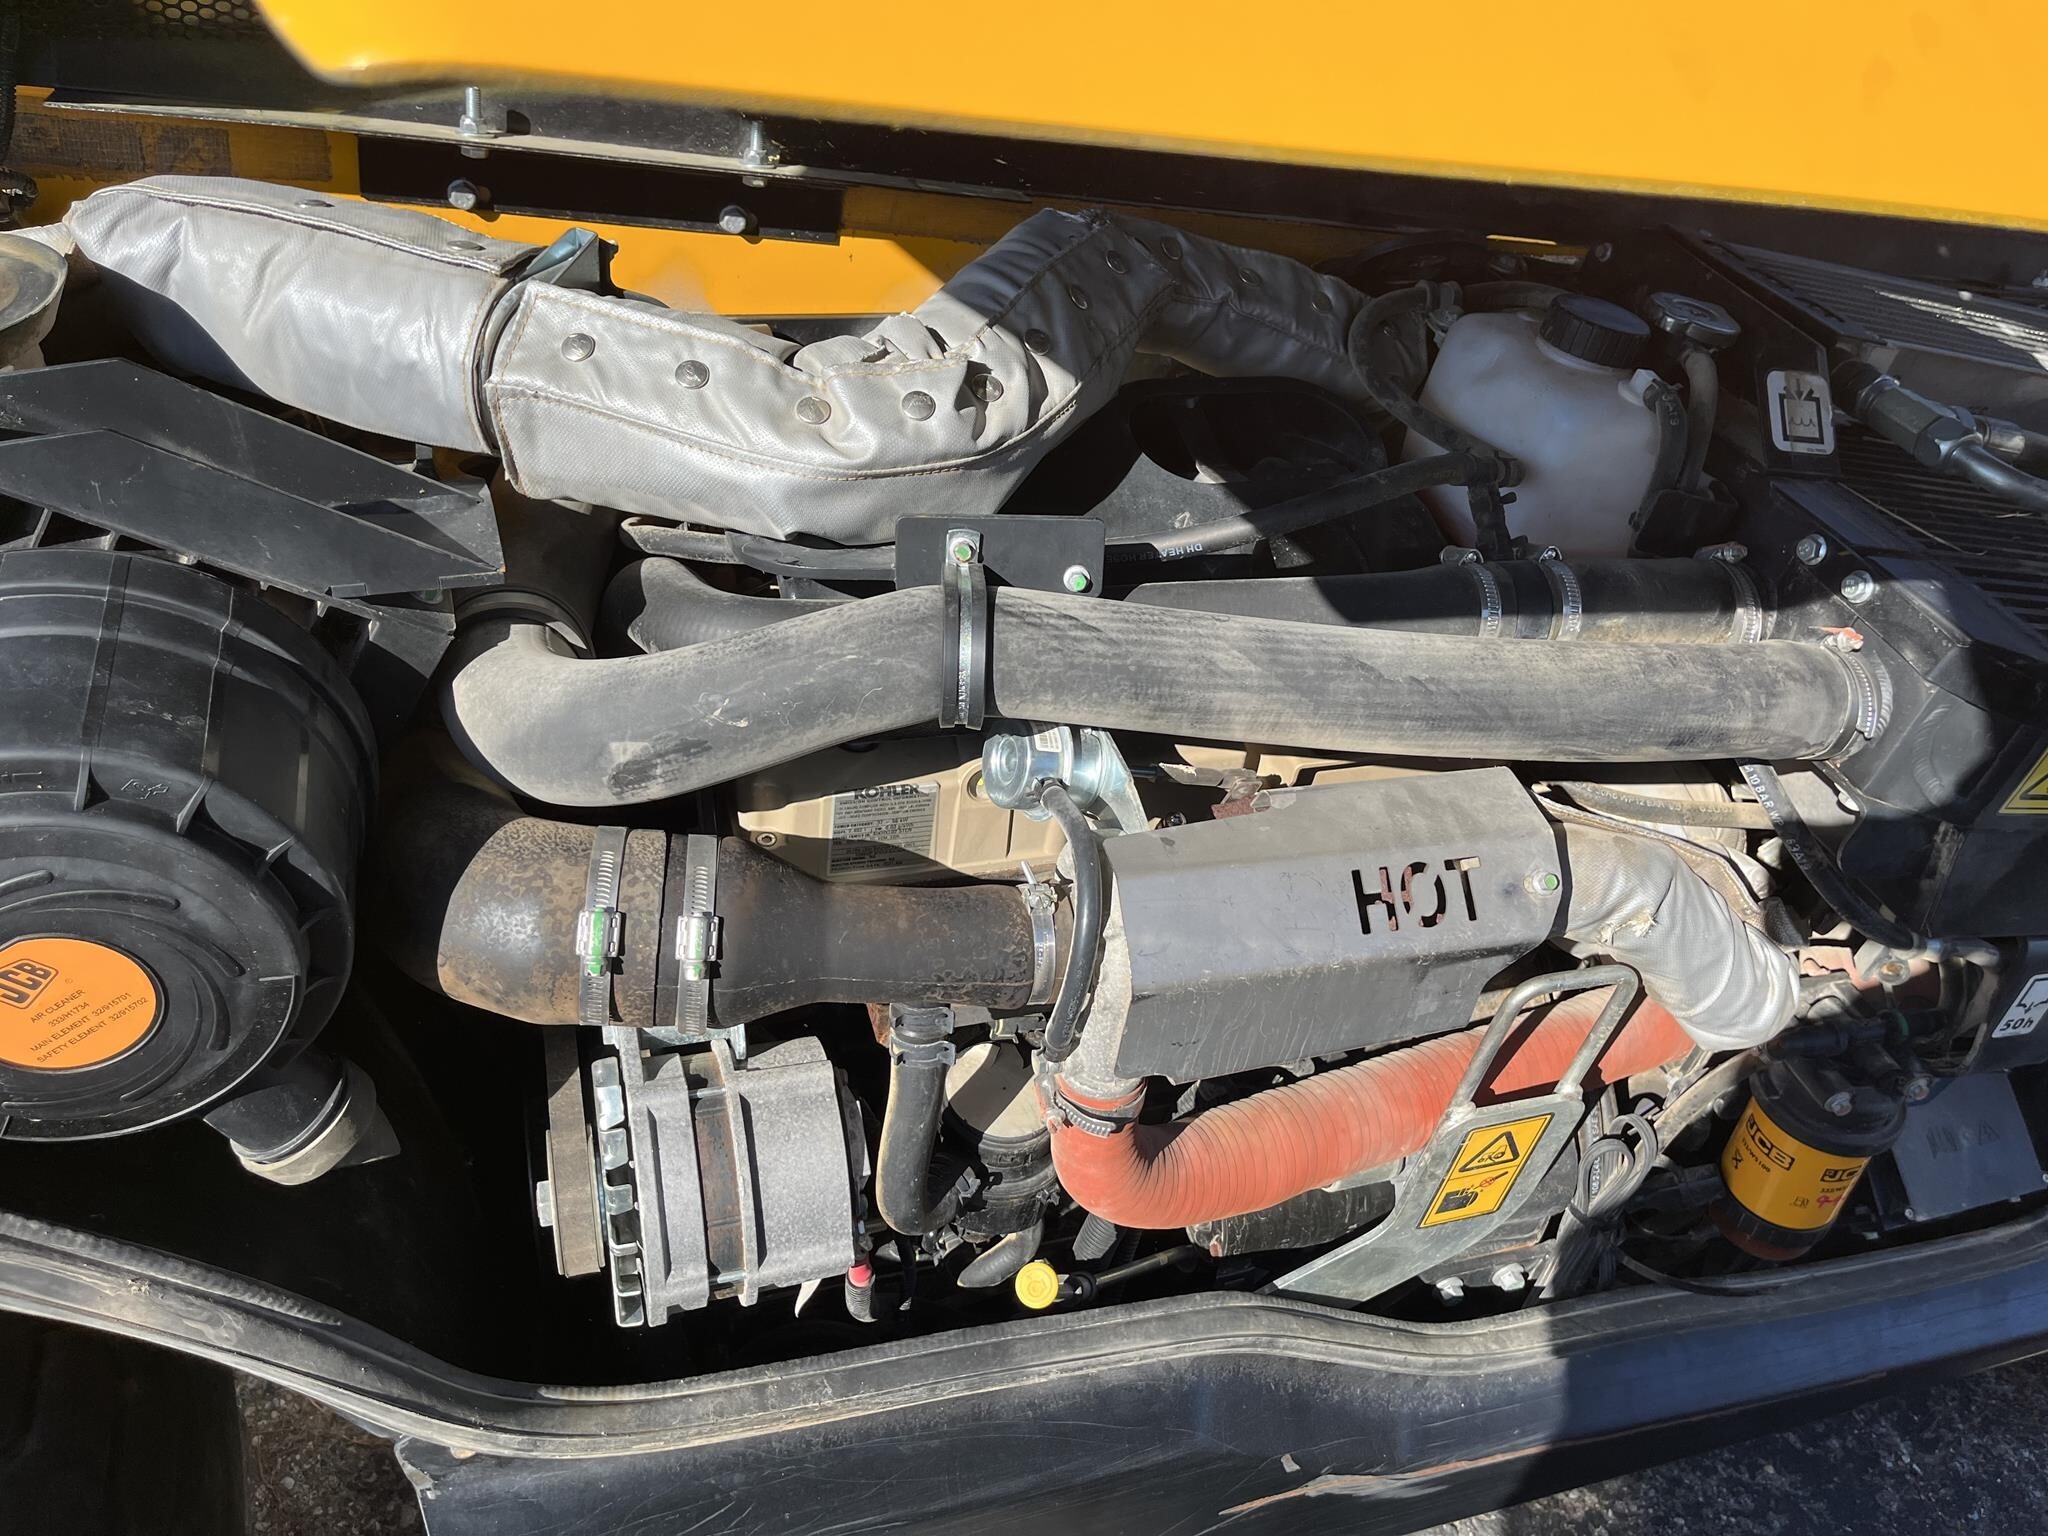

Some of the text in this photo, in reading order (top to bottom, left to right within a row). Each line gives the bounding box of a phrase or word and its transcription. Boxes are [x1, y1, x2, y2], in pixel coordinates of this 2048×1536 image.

[1140, 545, 1185, 561] HEATER
[1186, 543, 1203, 554] DH
[855, 784, 920, 799] KOHLER
[1755, 785, 1775, 809] BAR
[1351, 856, 1482, 935] HOT
[0, 962, 52, 1003] JCB
[30, 989, 86, 1023] AIR CLEANER
[30, 992, 132, 1052] MAIN ELEMENT 32/915701
[37, 997, 149, 1062] SAFETY ELEMENT 32/915702
[2000, 1017, 2034, 1031] 50h
[1746, 1113, 1796, 1171] JCB
[1821, 1166, 1861, 1182] JC
